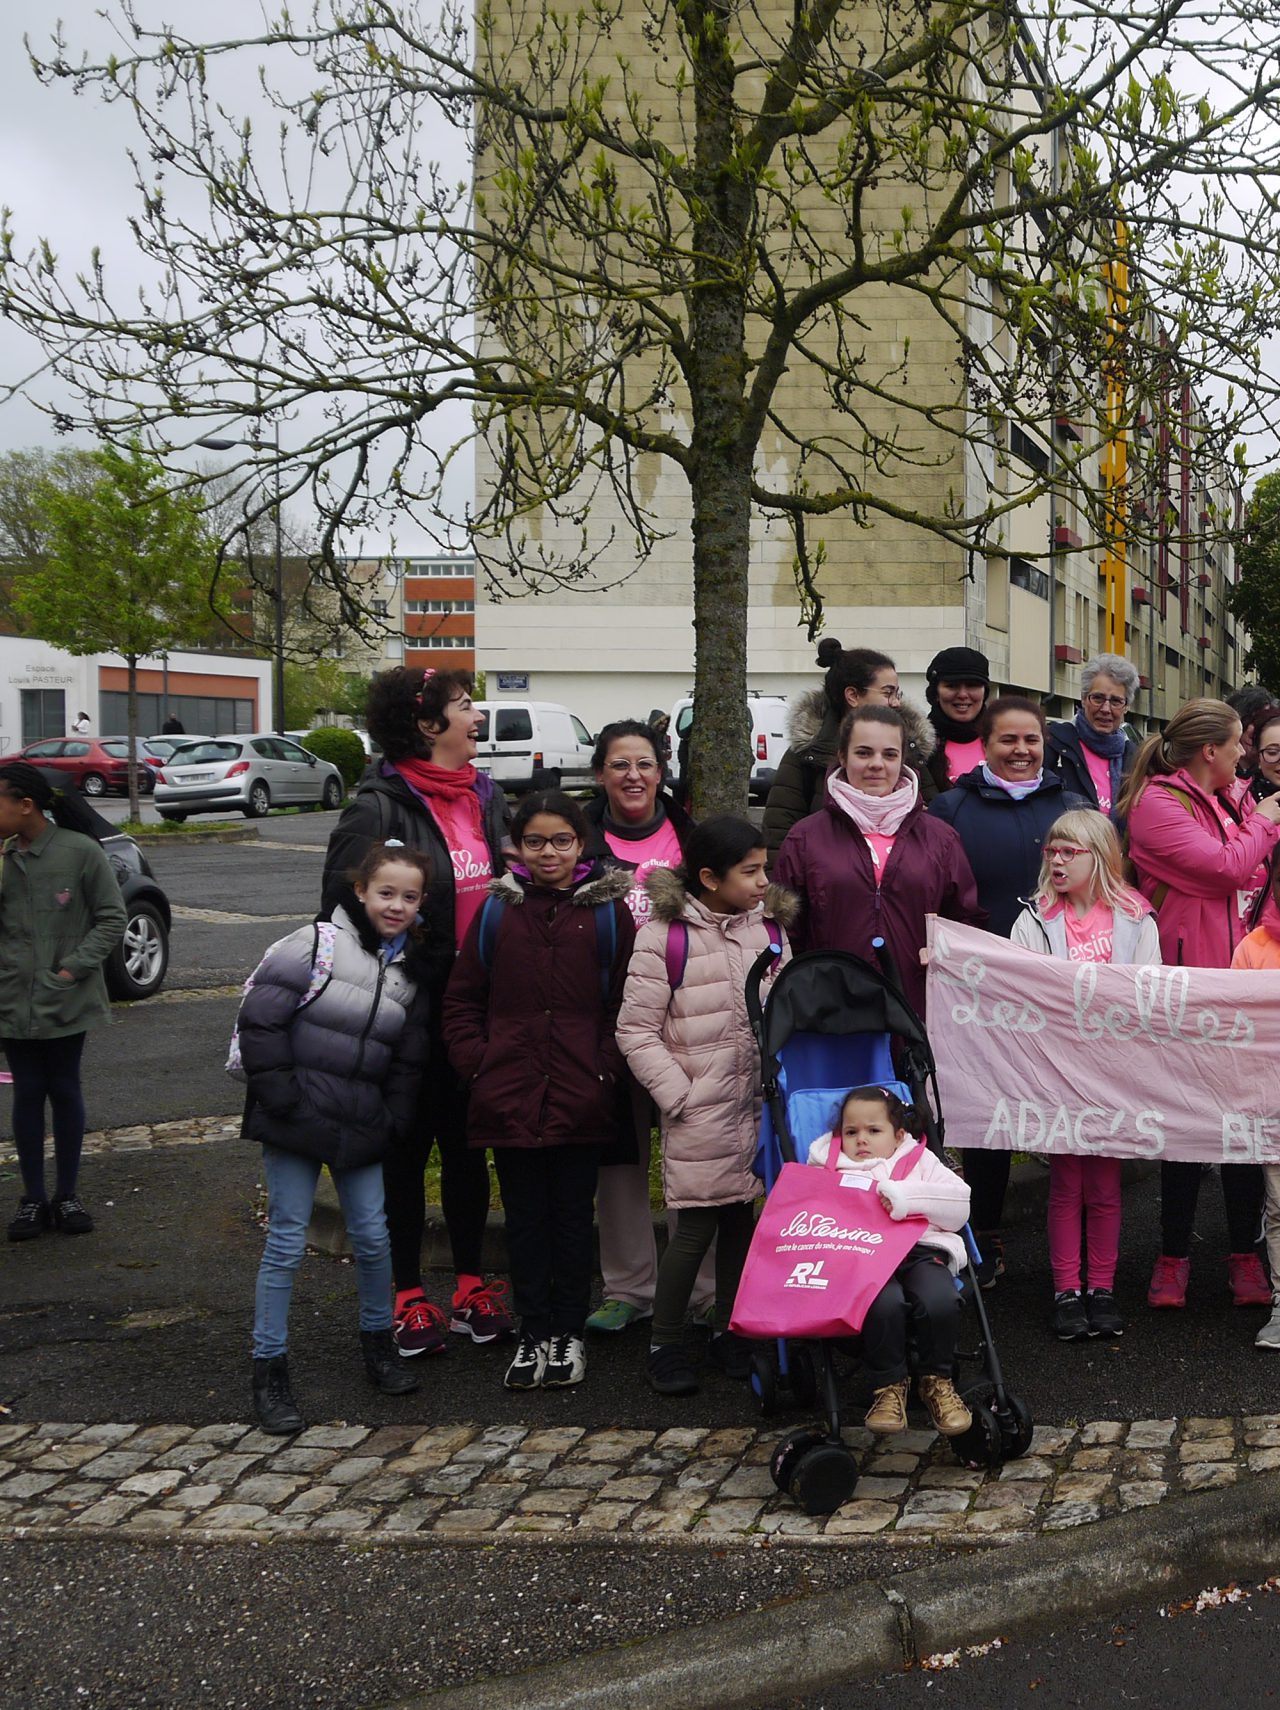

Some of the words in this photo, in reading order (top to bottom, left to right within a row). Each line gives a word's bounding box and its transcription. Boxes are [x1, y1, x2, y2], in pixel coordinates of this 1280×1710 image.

[25, 664, 56, 673] Espace
[32, 675, 74, 684] PASTEUR
[1073, 962, 1255, 1048] belles
[983, 1097, 1166, 1156] ADAC'S
[798, 1242, 814, 1251] cancer
[785, 1260, 829, 1287] RL
